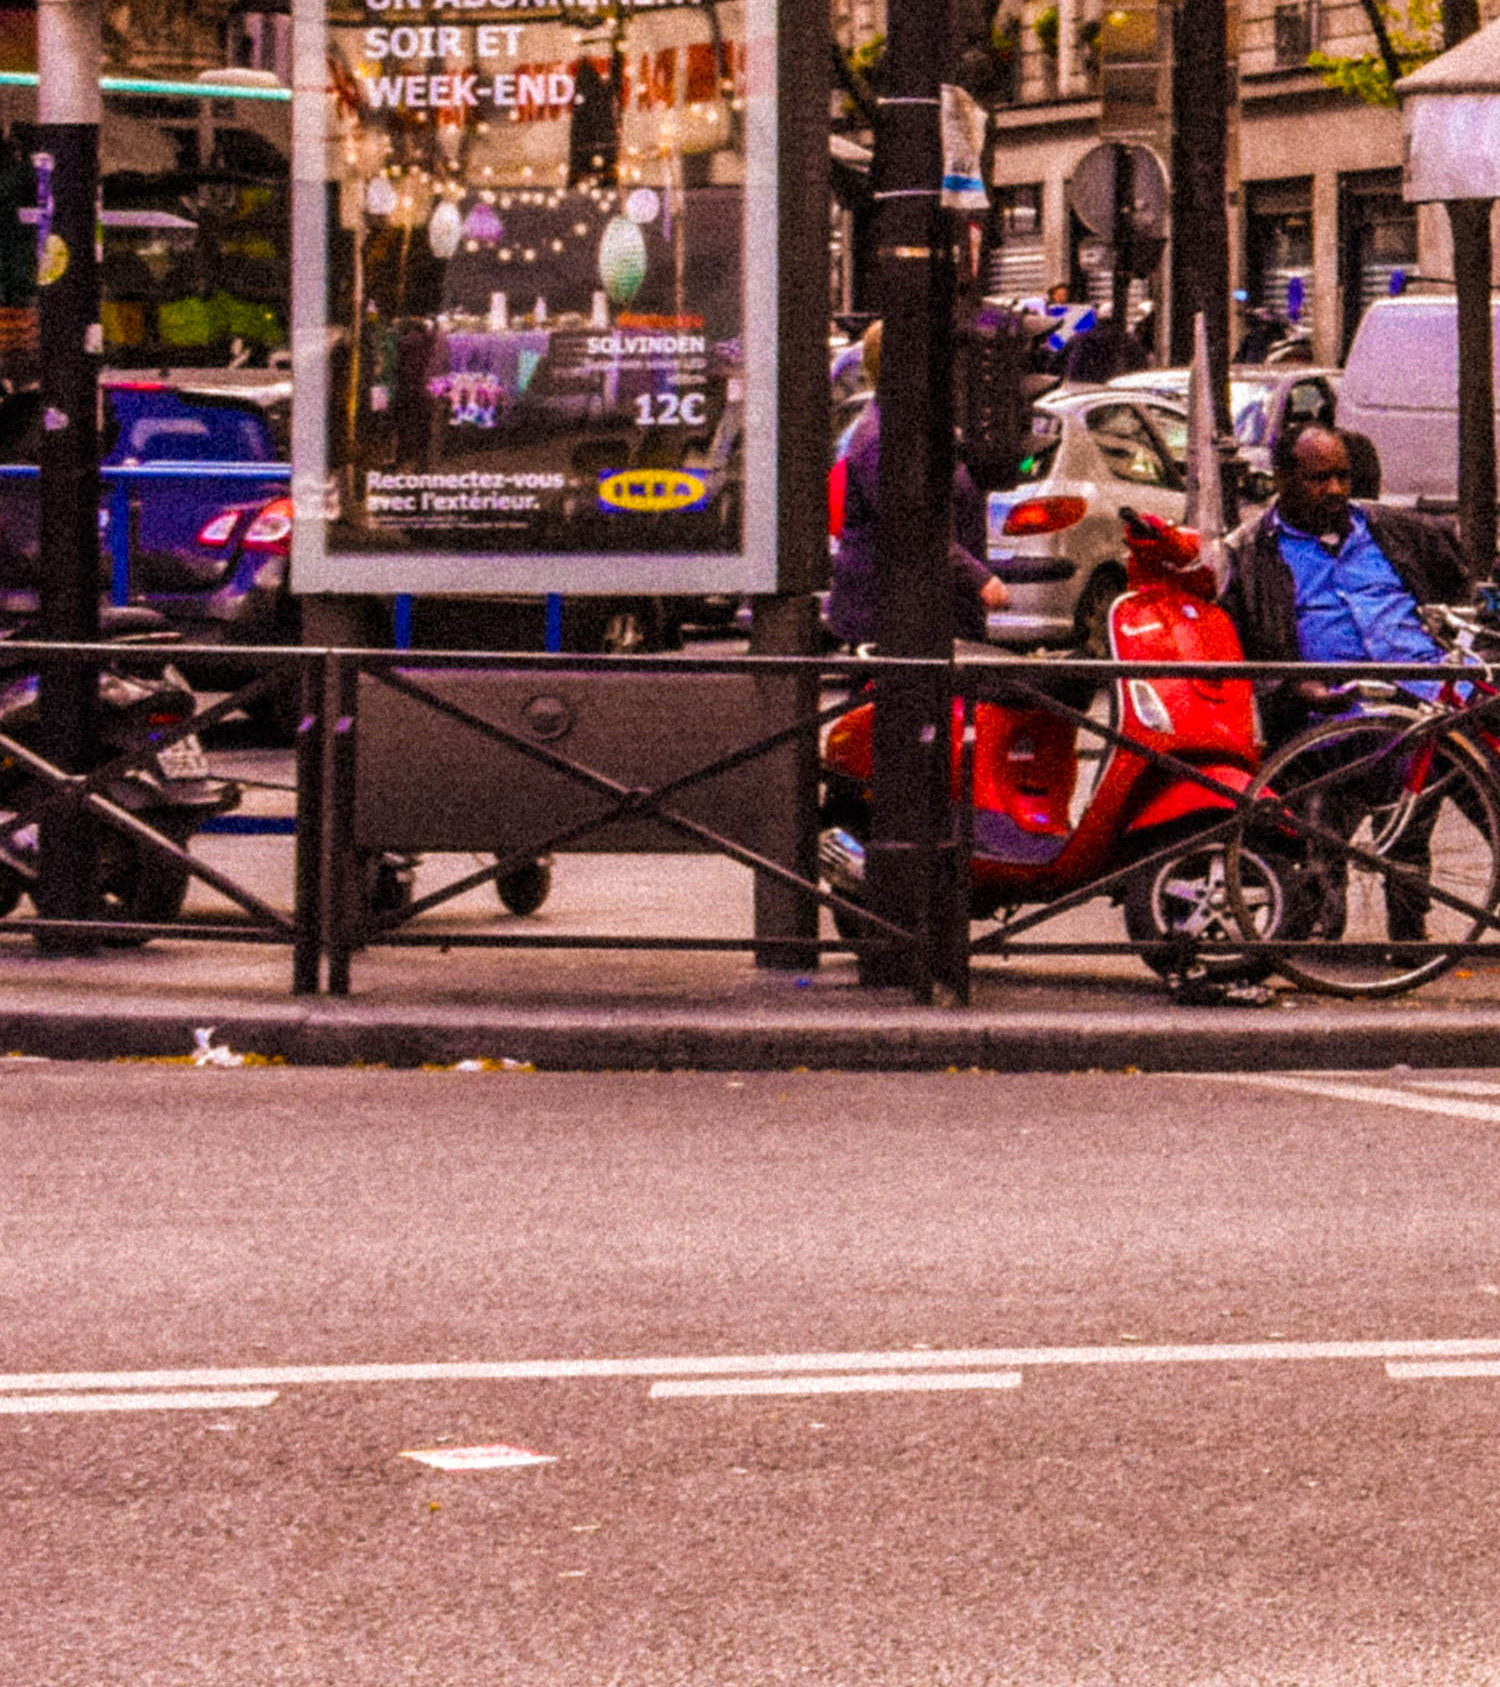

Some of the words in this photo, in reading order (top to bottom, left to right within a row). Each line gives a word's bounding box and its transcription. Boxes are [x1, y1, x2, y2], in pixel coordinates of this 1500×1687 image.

[363, 26, 462, 59] SOIR
[476, 25, 524, 57] ET
[362, 73, 585, 108] WEEK-END.
[587, 335, 705, 355] SOLVINDEN
[635, 392, 706, 425] 12€
[367, 471, 564, 489] Reconnectez-vous
[615, 482, 691, 497] IKEA
[367, 495, 415, 511] avec
[421, 491, 540, 511] l'extérieur.
